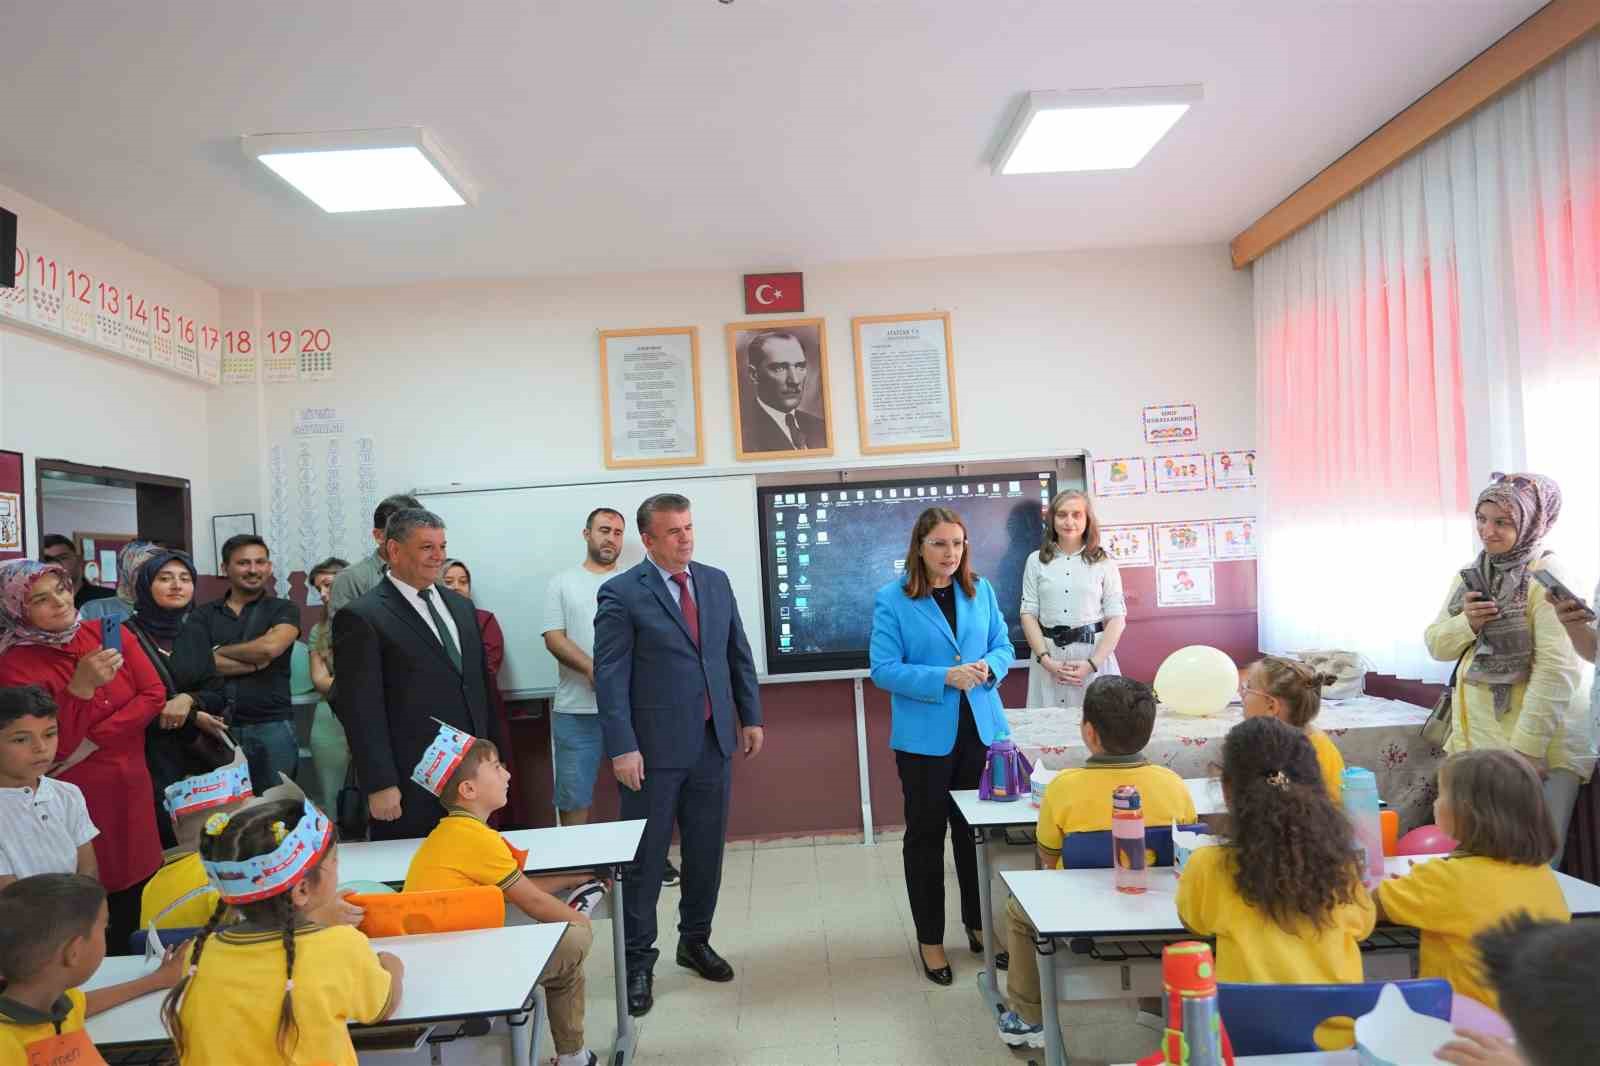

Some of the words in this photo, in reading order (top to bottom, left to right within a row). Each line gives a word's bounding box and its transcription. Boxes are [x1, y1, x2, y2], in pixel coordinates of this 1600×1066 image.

[37, 256, 57, 290] 11
[67, 269, 91, 304] 12
[98, 282, 119, 314] 13
[126, 293, 148, 325] 14
[153, 304, 171, 334] 15
[177, 316, 195, 343] 16
[202, 325, 219, 350] 17
[224, 330, 252, 353] 18
[266, 330, 293, 353] 19
[300, 328, 331, 352] 20
